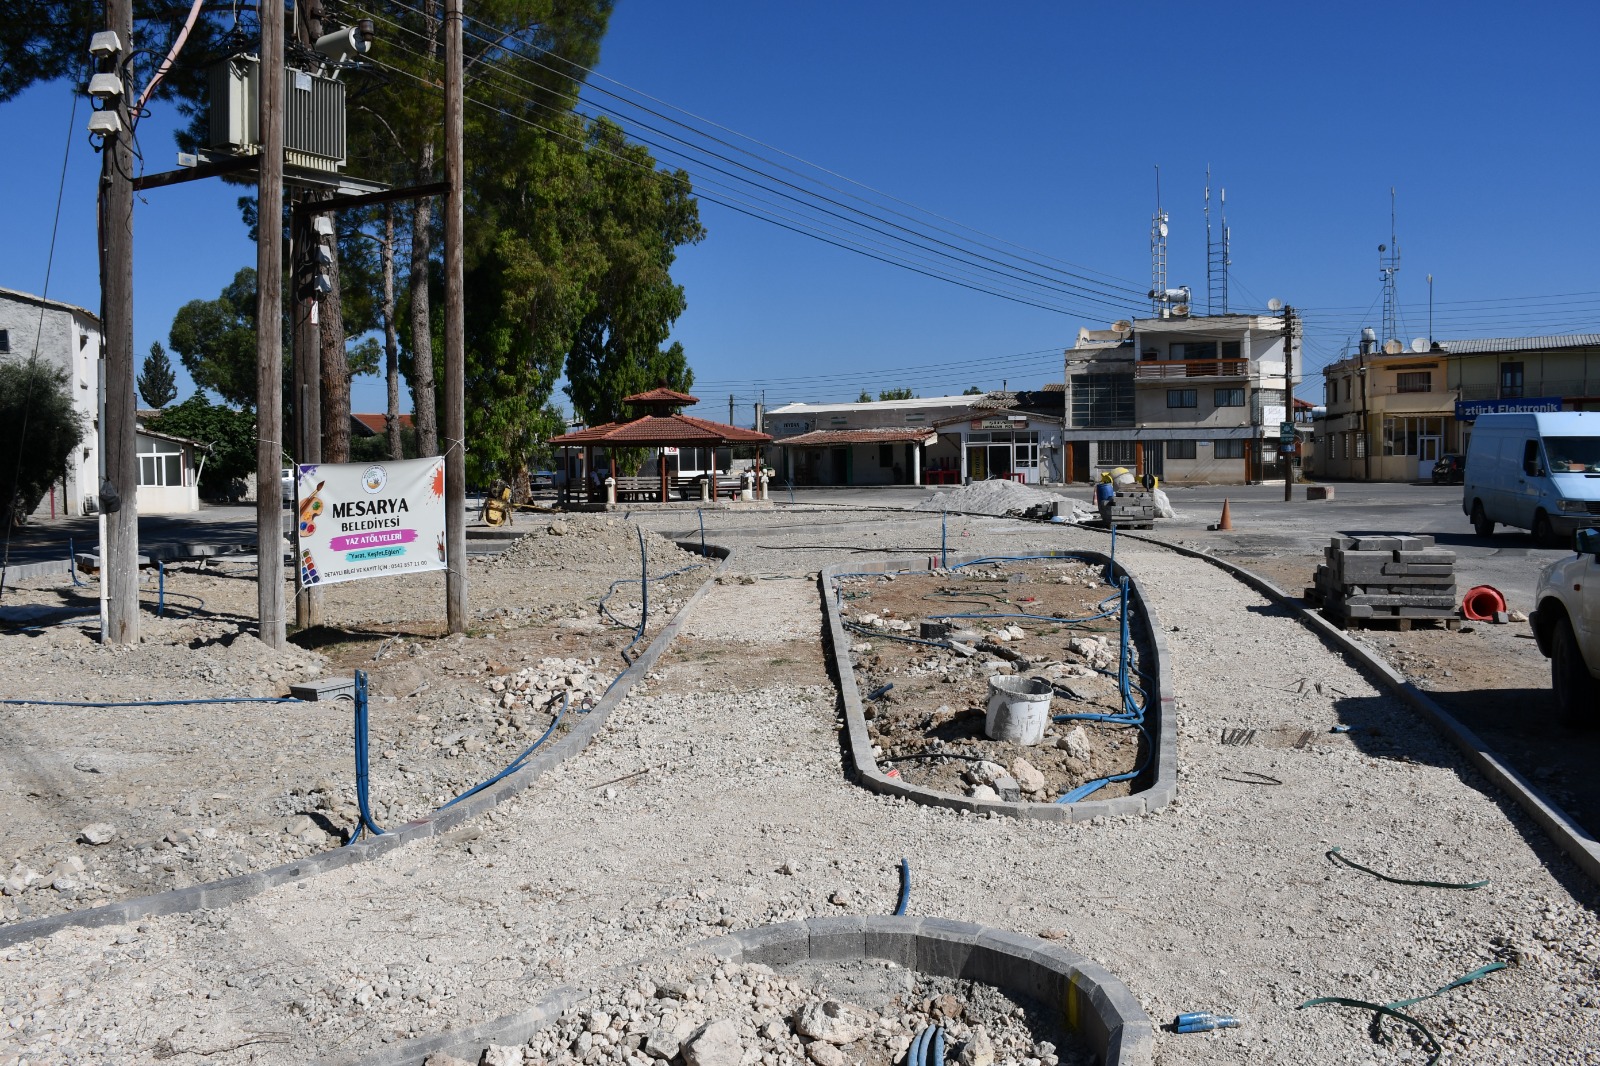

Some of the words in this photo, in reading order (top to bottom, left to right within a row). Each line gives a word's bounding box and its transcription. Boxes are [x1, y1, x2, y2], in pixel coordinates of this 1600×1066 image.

[1497, 403, 1558, 413] Elektronik
[332, 497, 409, 519] MESARYA
[341, 515, 400, 532] BELEDİYESİ
[345, 537, 359, 546] YAZ
[360, 531, 402, 544] ATÖLYELERİ
